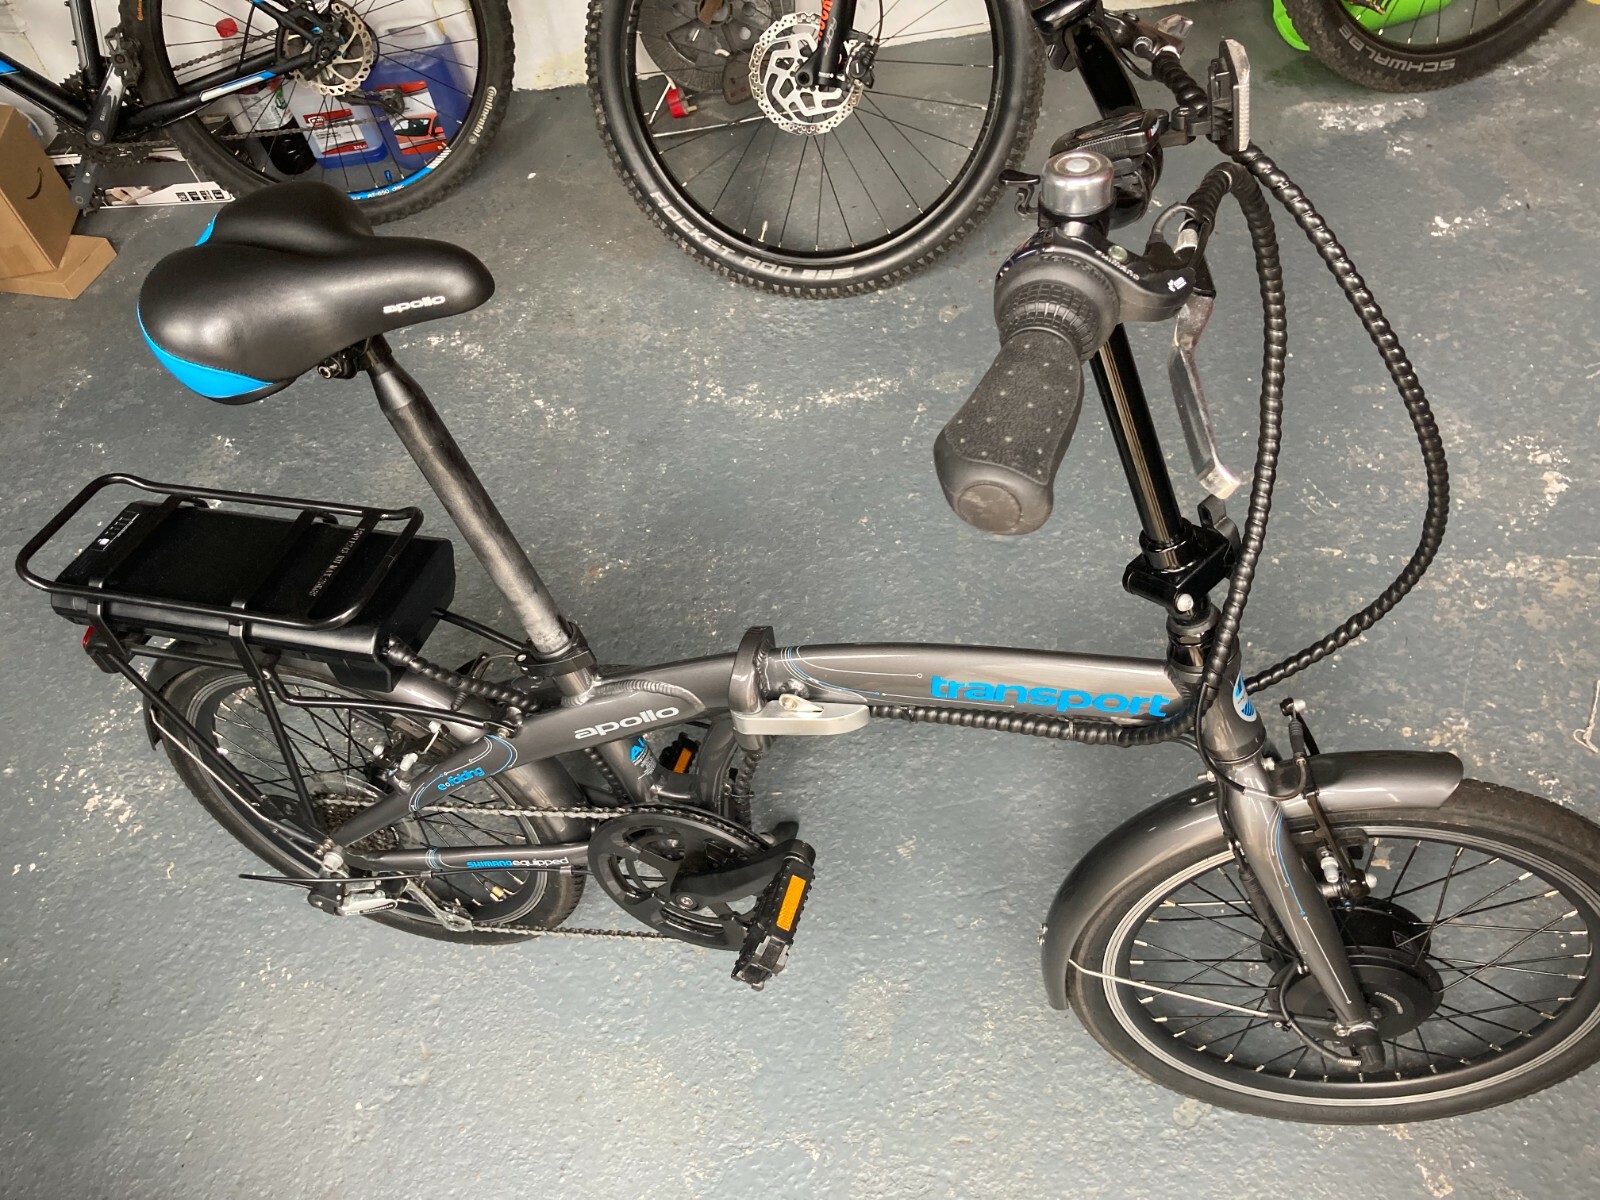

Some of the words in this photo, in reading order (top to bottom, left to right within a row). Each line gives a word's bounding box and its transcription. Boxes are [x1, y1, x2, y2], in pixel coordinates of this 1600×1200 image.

[1338, 24, 1457, 73] SCHWALBE
[470, 85, 498, 138] Continental
[649, 190, 736, 257] ROCKET
[740, 255, 794, 277] RON
[382, 295, 446, 314] apollo
[930, 675, 1171, 718] transport
[573, 706, 680, 740] apollo
